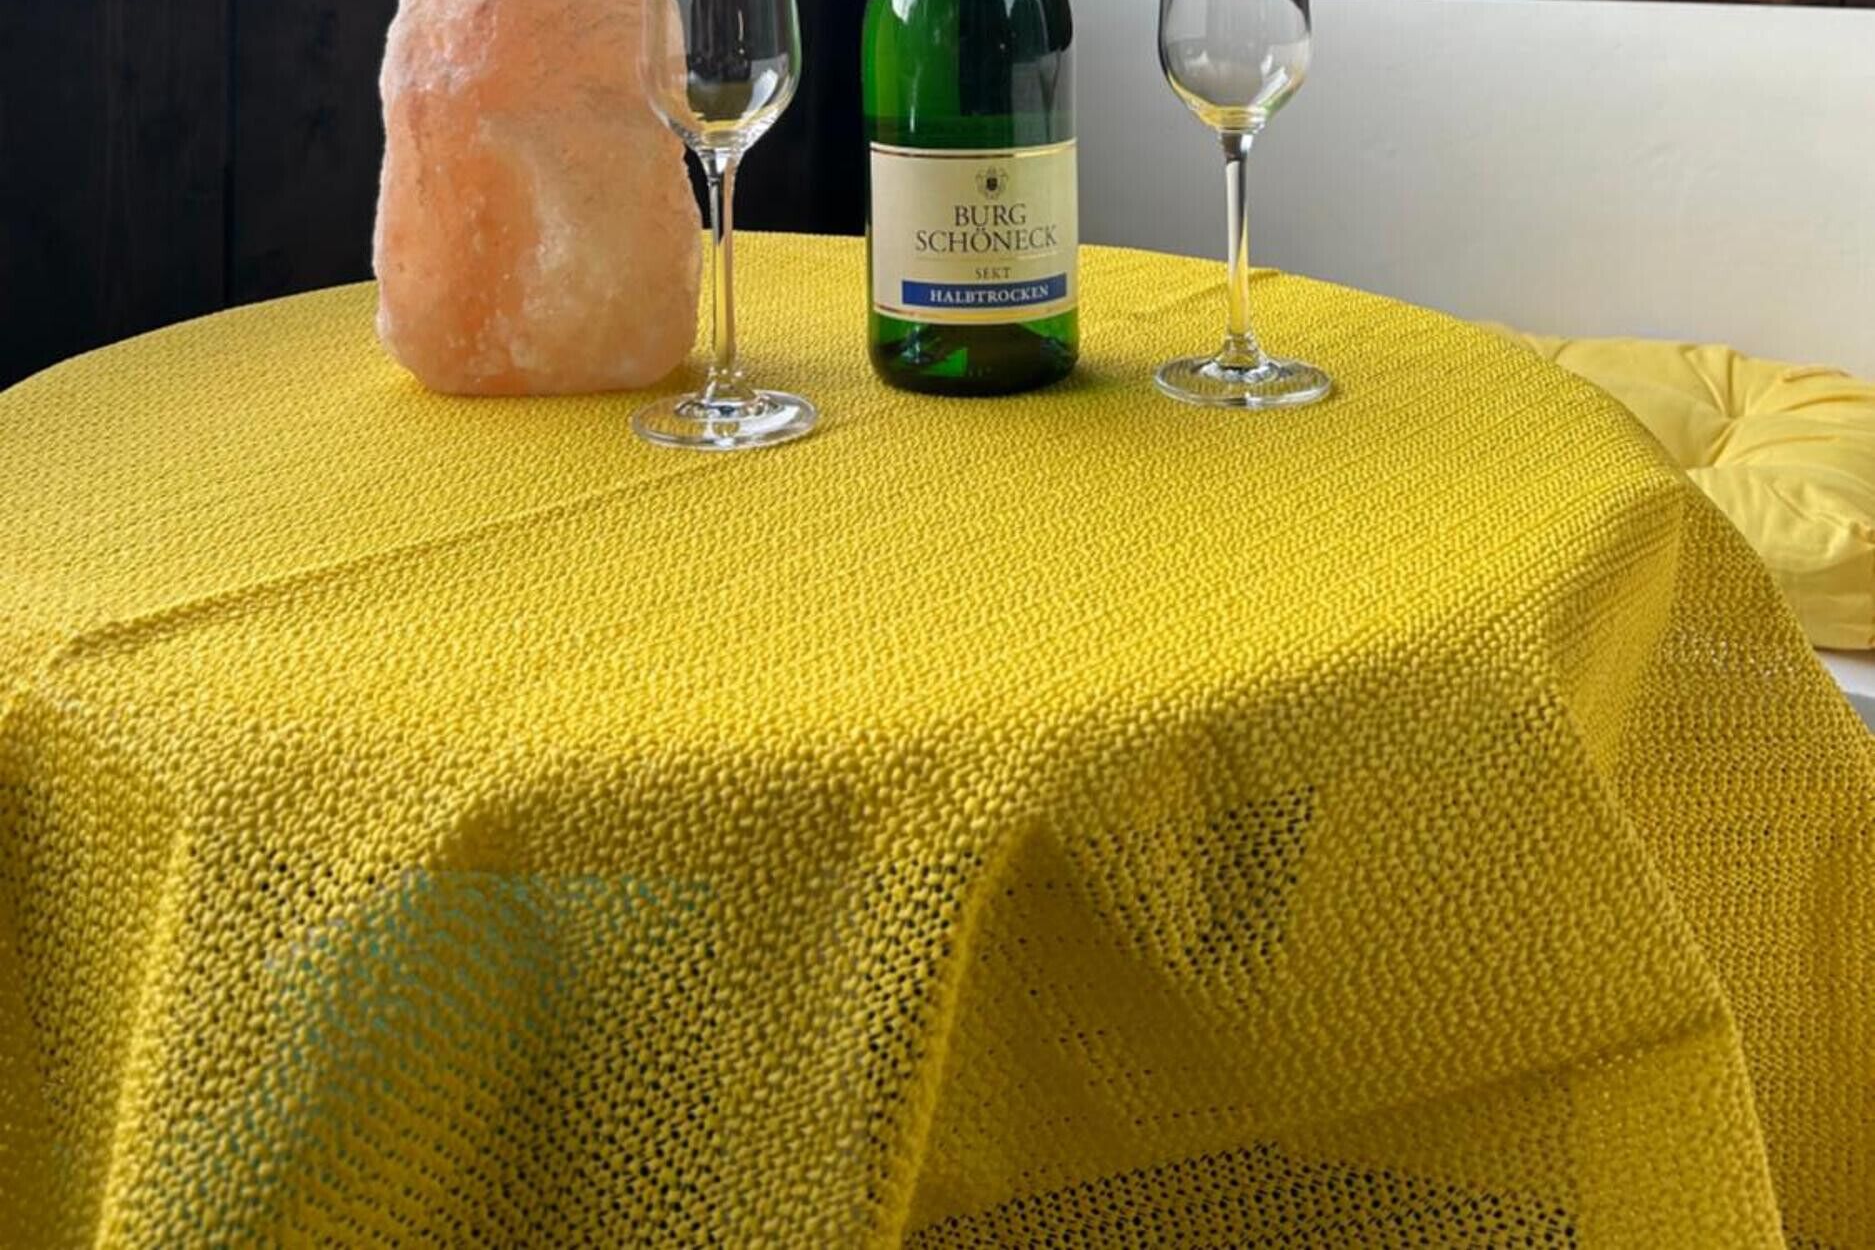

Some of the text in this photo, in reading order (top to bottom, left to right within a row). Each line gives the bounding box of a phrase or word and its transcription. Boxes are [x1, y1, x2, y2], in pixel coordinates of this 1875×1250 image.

[955, 204, 1026, 227] BURG
[915, 225, 1057, 252] SCHÖNECK
[975, 267, 1011, 279] SEKT
[930, 285, 1049, 303] HALBTROCKEN
